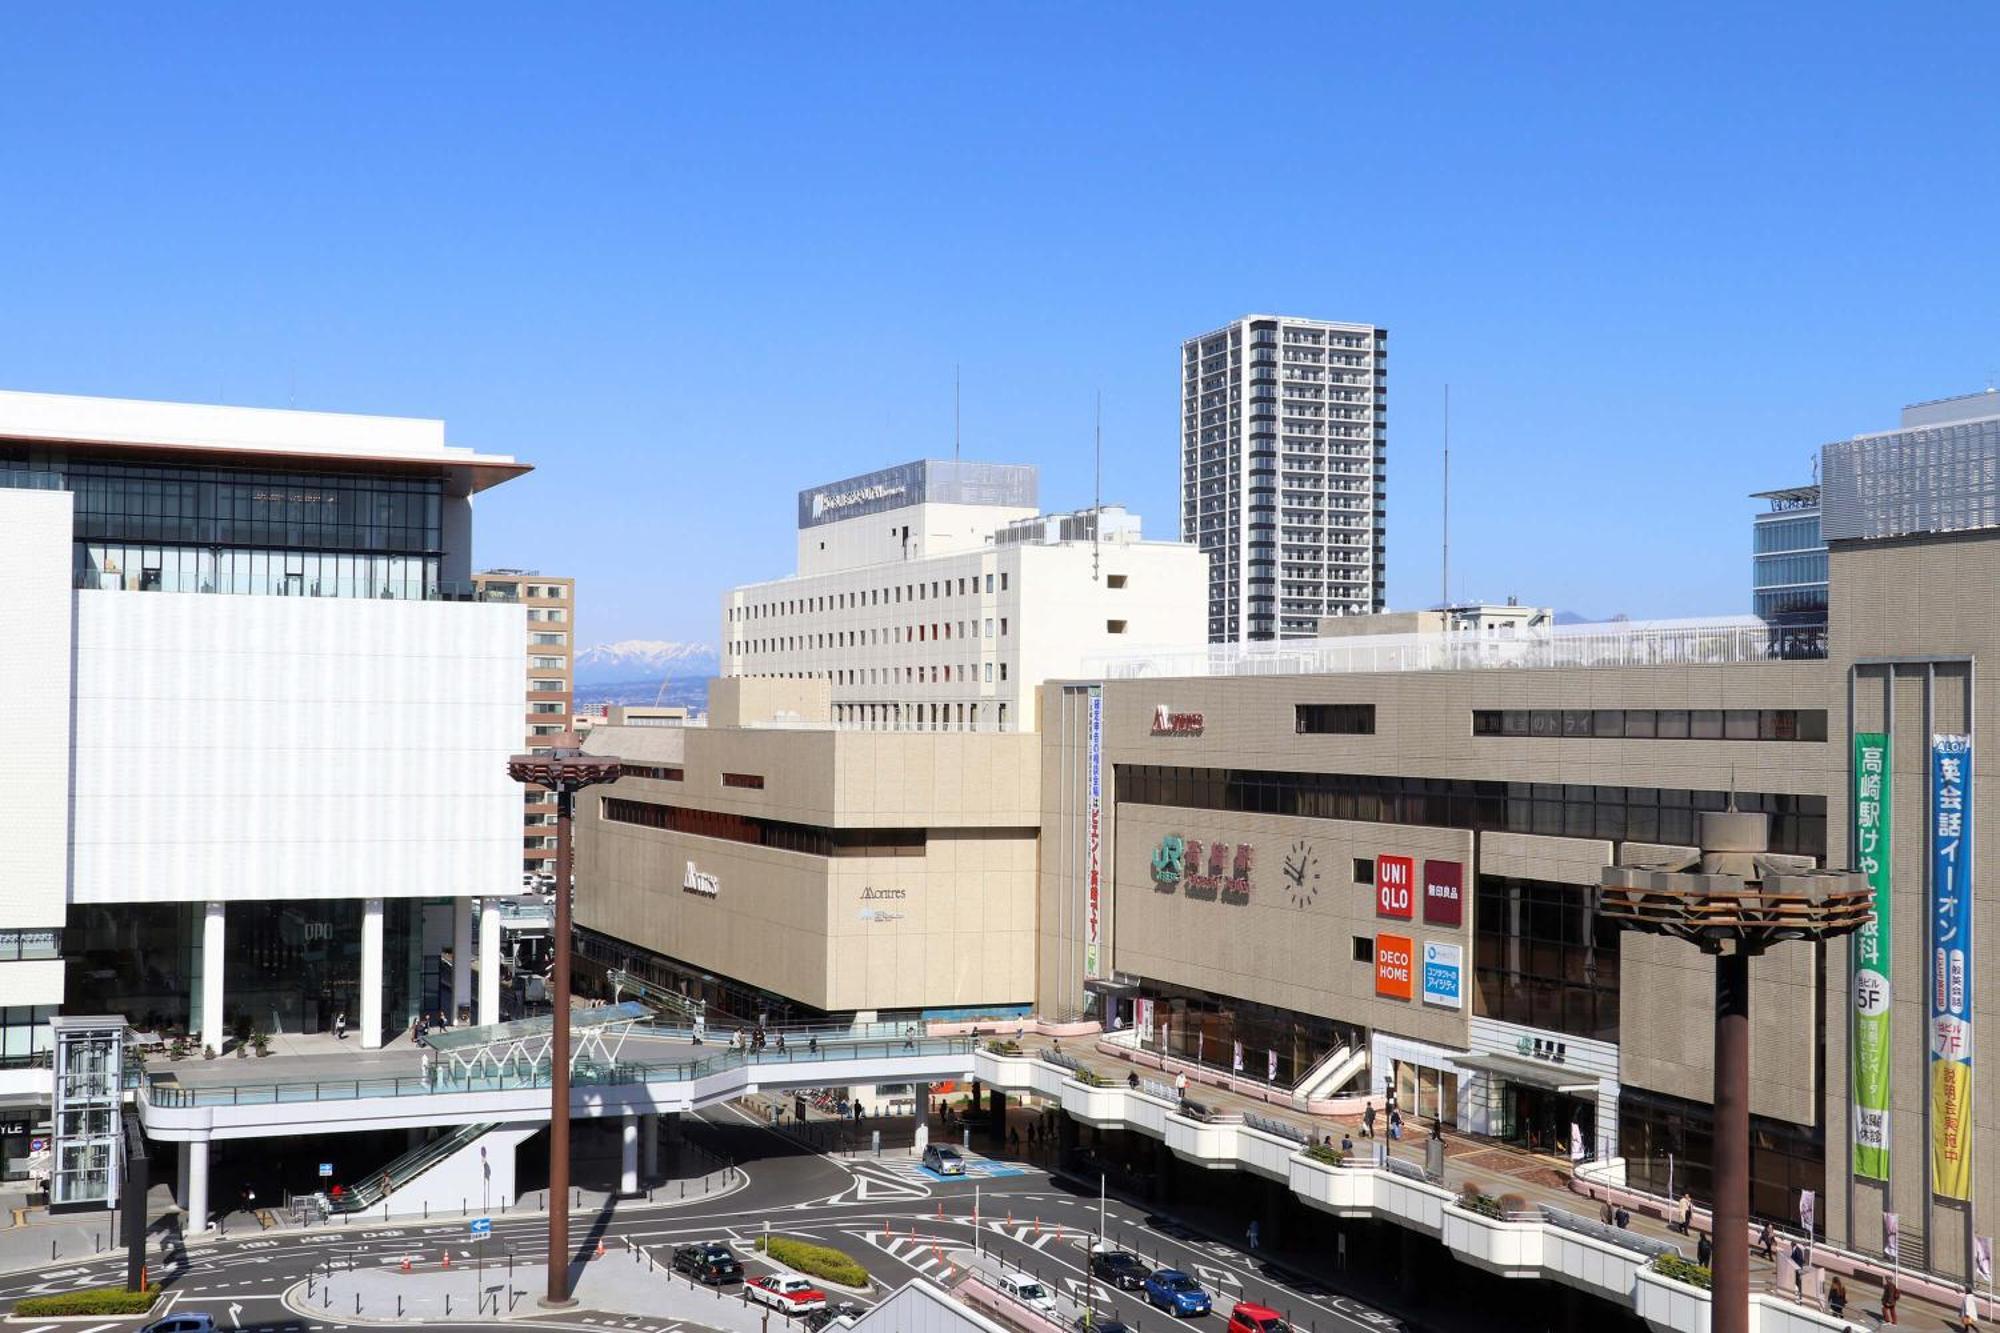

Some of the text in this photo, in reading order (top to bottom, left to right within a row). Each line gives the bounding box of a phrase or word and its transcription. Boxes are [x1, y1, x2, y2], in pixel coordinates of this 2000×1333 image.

[1858, 746, 1884, 965] 高崎駅けや眼科
[1938, 758, 1962, 942] 英会話イーオン
[1381, 862, 1407, 885] UNI
[1381, 886, 1409, 910] QLO
[1380, 950, 1409, 966] DECO
[1380, 965, 1409, 982] HOME
[1857, 988, 1881, 1010] 5F
[1937, 1033, 1962, 1054] 7F
